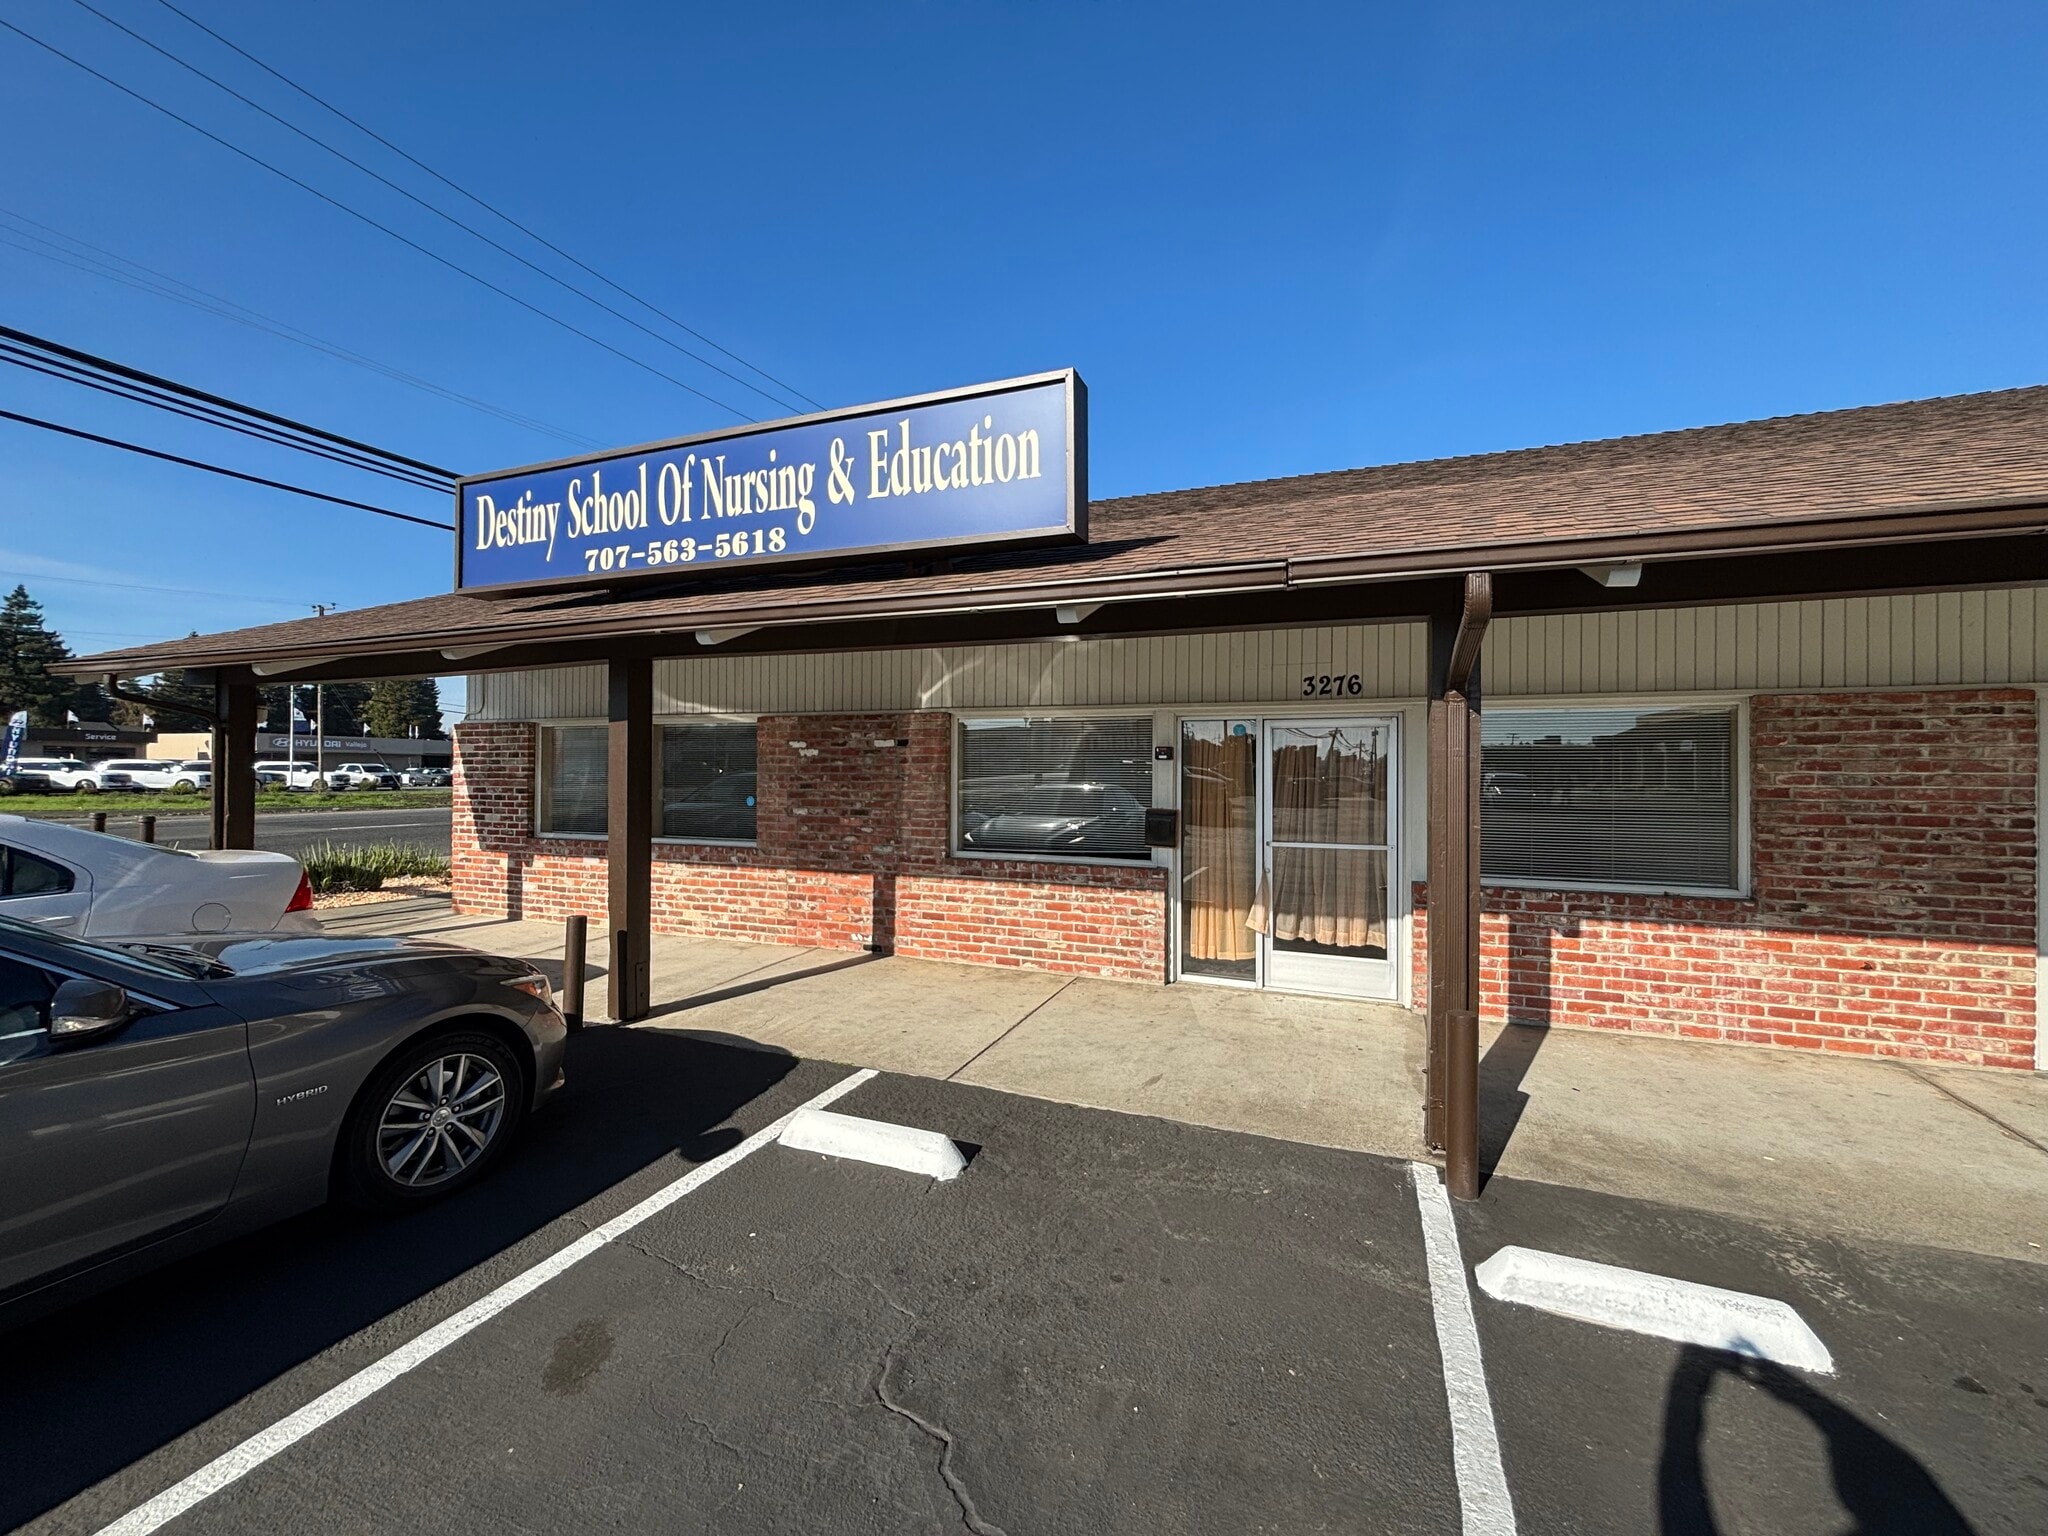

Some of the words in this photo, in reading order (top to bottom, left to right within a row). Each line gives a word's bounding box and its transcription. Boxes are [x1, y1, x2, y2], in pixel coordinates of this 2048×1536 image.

[476, 490, 561, 562] Destiny
[567, 462, 649, 539] School
[658, 453, 696, 527] Of
[701, 449, 817, 536] Nursing
[827, 437, 855, 506] &
[867, 415, 1042, 500] Education
[584, 527, 787, 573] 707-563-5618
[1303, 674, 1362, 697] 3276
[295, 739, 342, 748] HYUDAI
[276, 1085, 328, 1106] HYBRID
